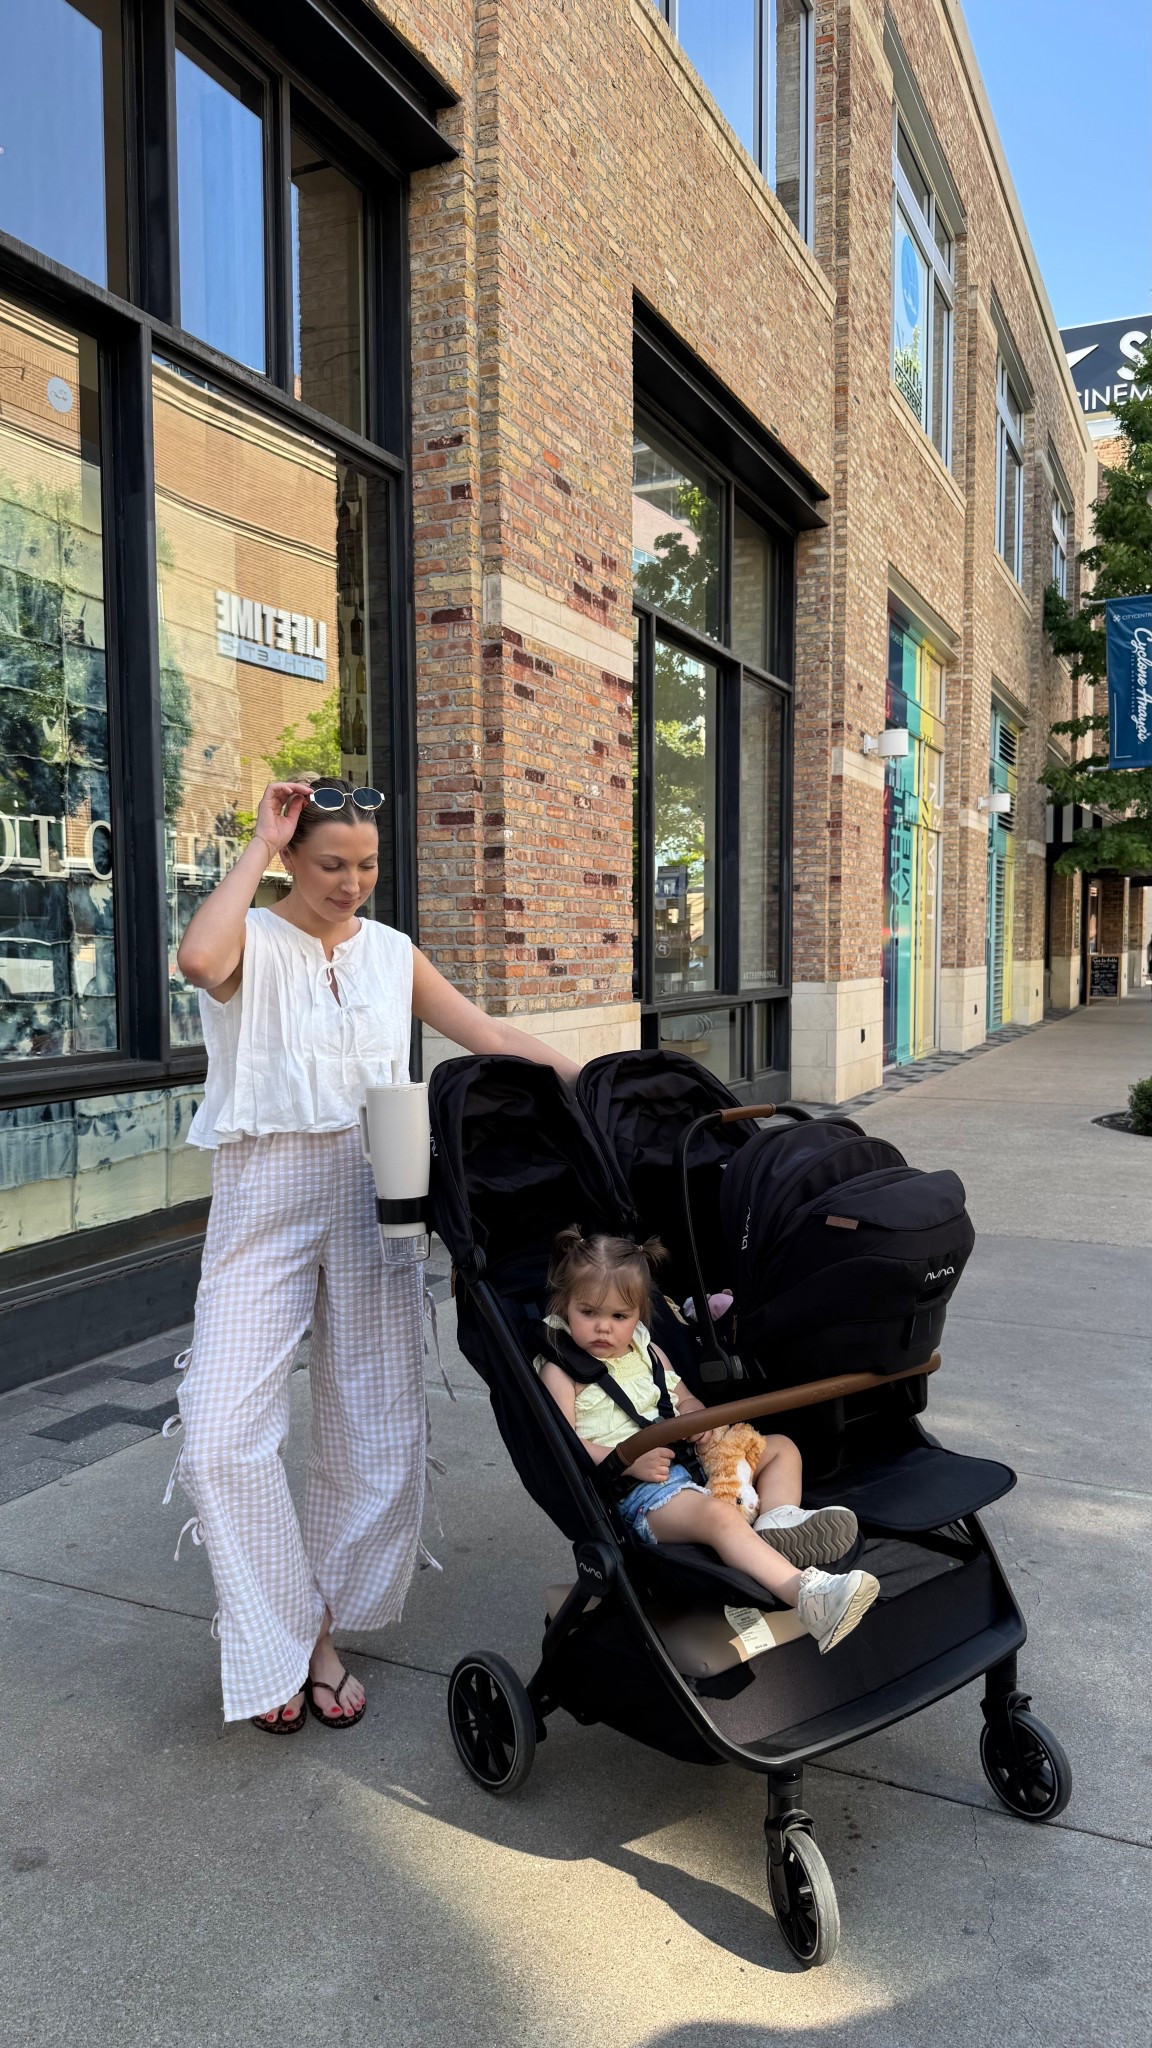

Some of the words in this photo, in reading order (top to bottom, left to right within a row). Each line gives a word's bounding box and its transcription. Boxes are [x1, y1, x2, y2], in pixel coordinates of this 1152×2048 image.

[1117, 330, 1152, 381] S
[1077, 383, 1152, 411] INEM
[1130, 627, 1152, 688] Cyclone
[1130, 688, 1152, 743] Anaya's
[926, 782, 940, 920] LEARN
[924, 1266, 955, 1282] nuna
[579, 1562, 603, 1580] nuna
